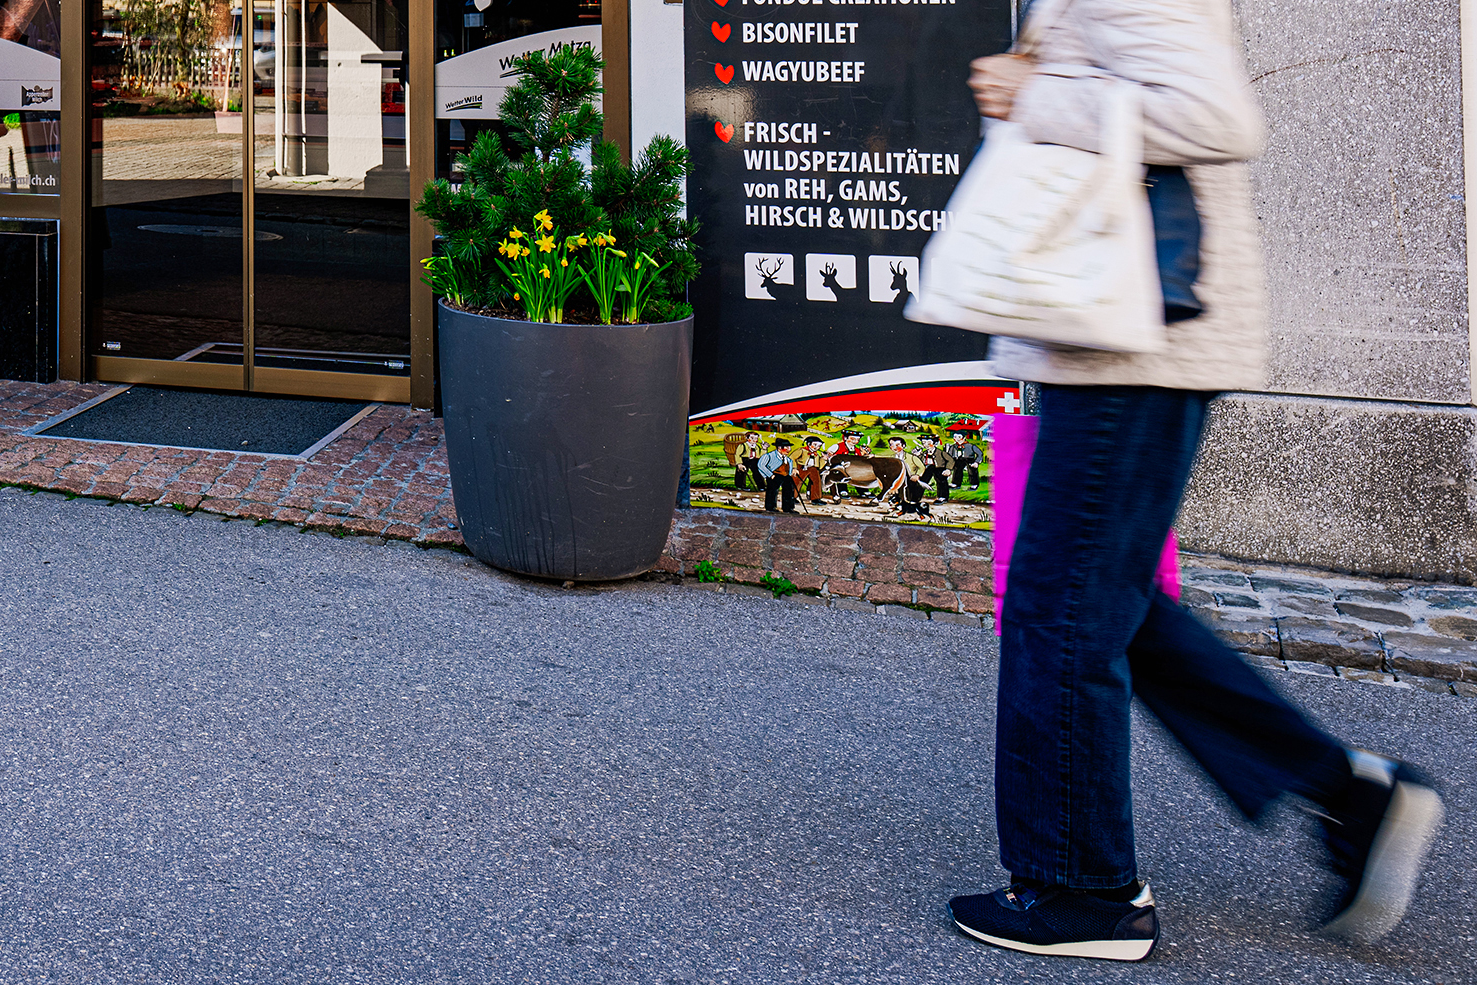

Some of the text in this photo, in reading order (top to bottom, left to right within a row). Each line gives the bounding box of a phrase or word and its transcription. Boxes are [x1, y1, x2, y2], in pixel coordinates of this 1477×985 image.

[742, 22, 859, 44] BISONFILET
[742, 60, 865, 83] WAGYUBEEF
[744, 148, 960, 175] WILDSPEZIALITÄTEN
[744, 178, 908, 206] von REH, GAMS,
[745, 204, 822, 228] HIRSCH
[827, 209, 844, 229] &
